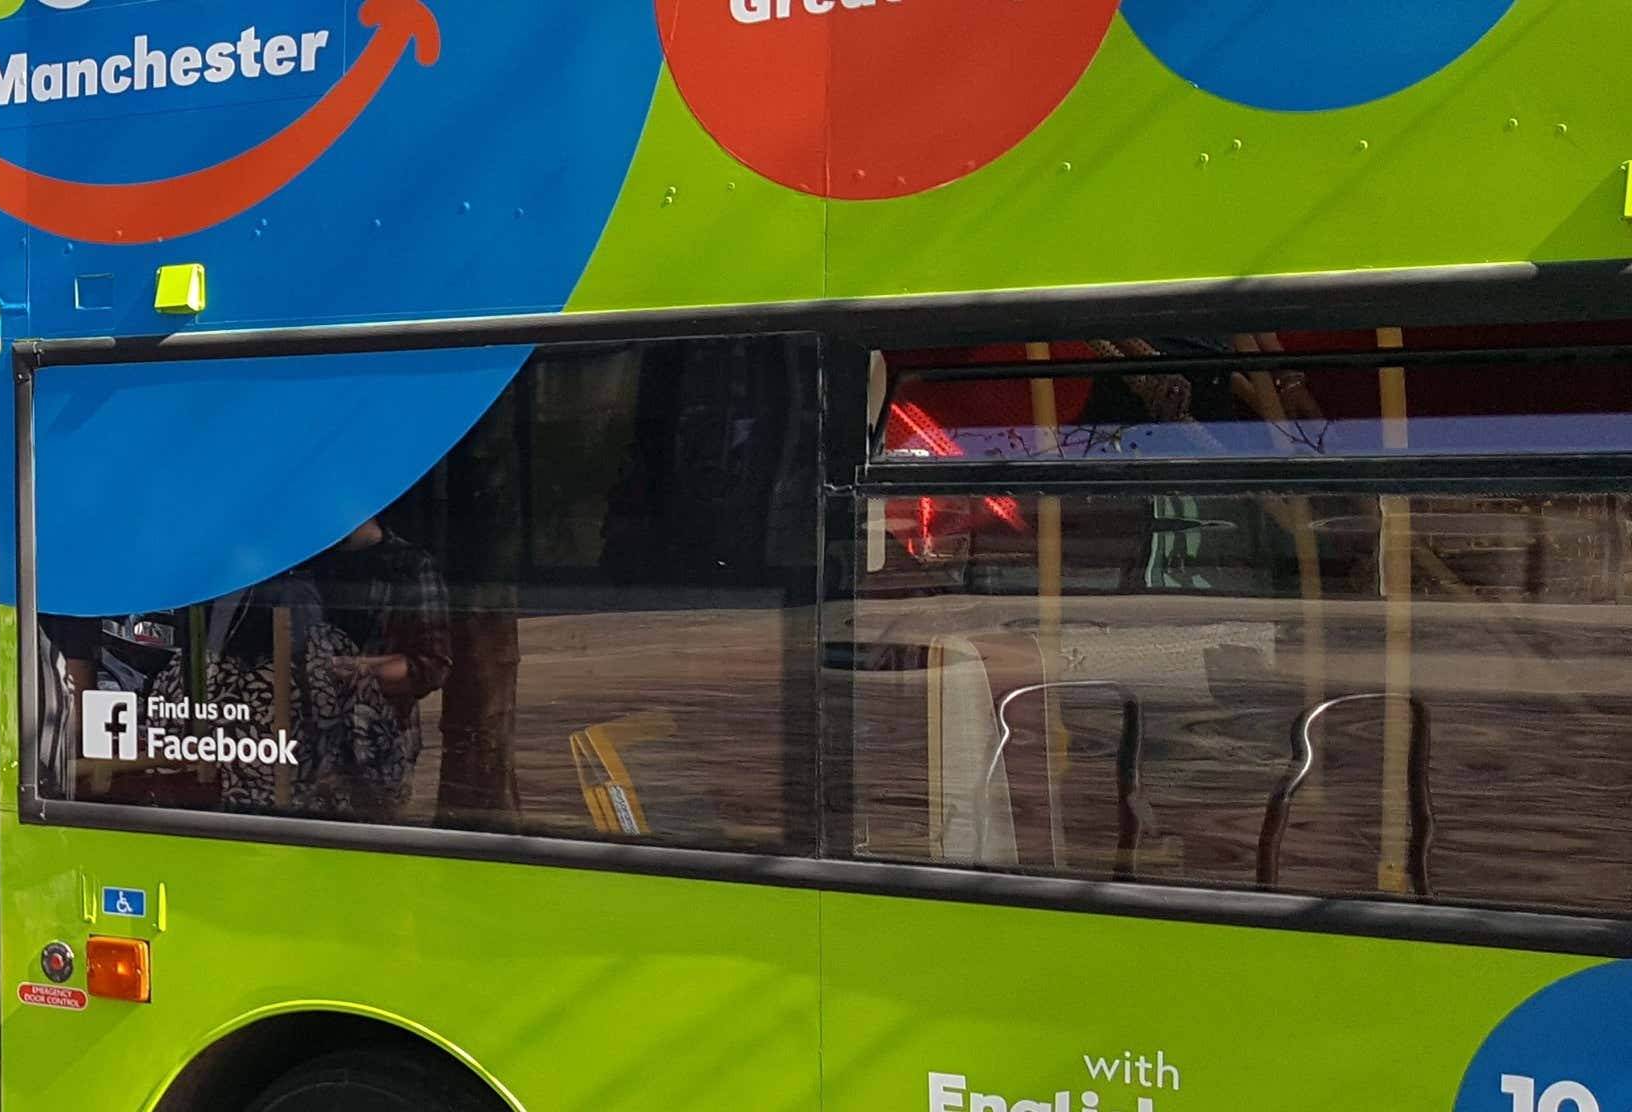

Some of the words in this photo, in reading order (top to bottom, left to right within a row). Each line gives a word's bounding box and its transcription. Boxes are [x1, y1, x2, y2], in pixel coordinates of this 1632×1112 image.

[147, 696, 189, 719] Find
[195, 702, 217, 720] us
[223, 703, 250, 721] on
[147, 727, 299, 765] Facebook
[1083, 1050, 1180, 1090] with
